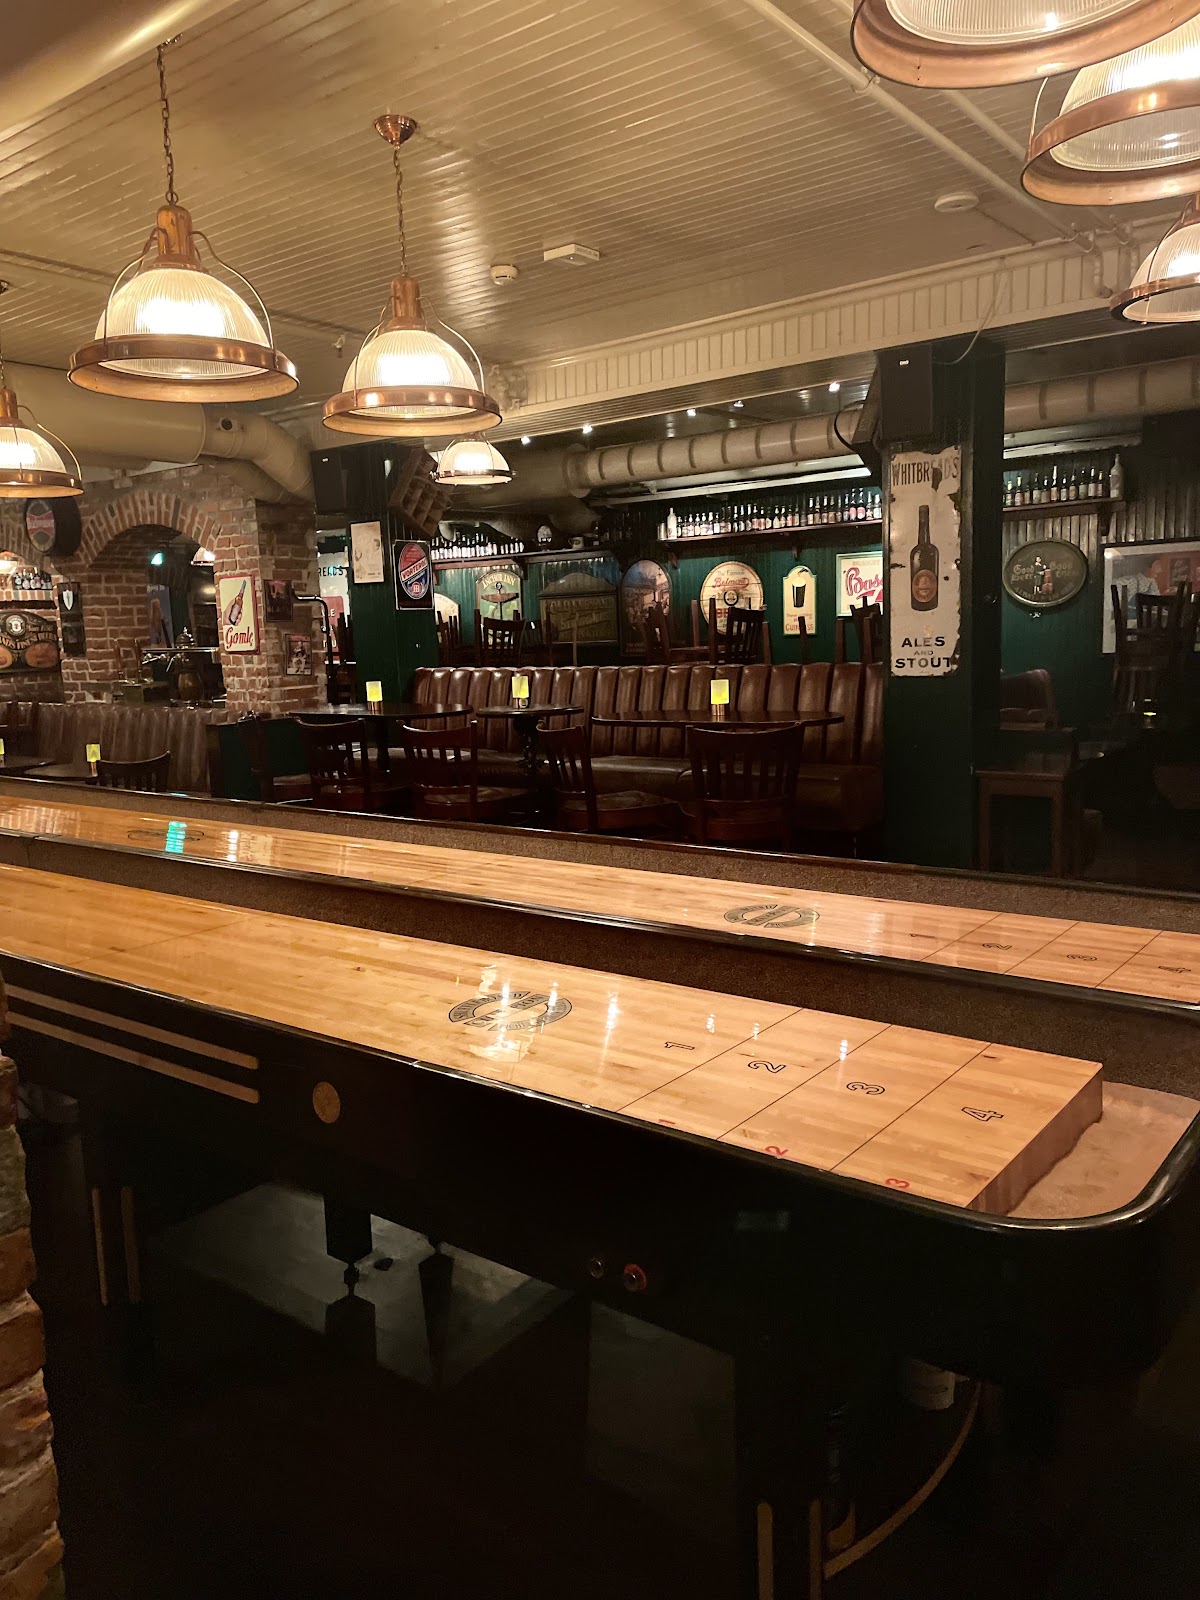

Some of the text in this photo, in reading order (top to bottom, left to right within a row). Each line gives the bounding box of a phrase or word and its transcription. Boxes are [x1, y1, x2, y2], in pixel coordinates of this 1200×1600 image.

[901, 636, 946, 648] ALES
[895, 657, 951, 669] STOUT
[664, 1041, 696, 1051] 1
[747, 1060, 787, 1074] 2
[846, 1081, 886, 1096] 3
[961, 1106, 1005, 1122] 4
[764, 1145, 789, 1156] 2
[885, 1177, 910, 1190] 3
